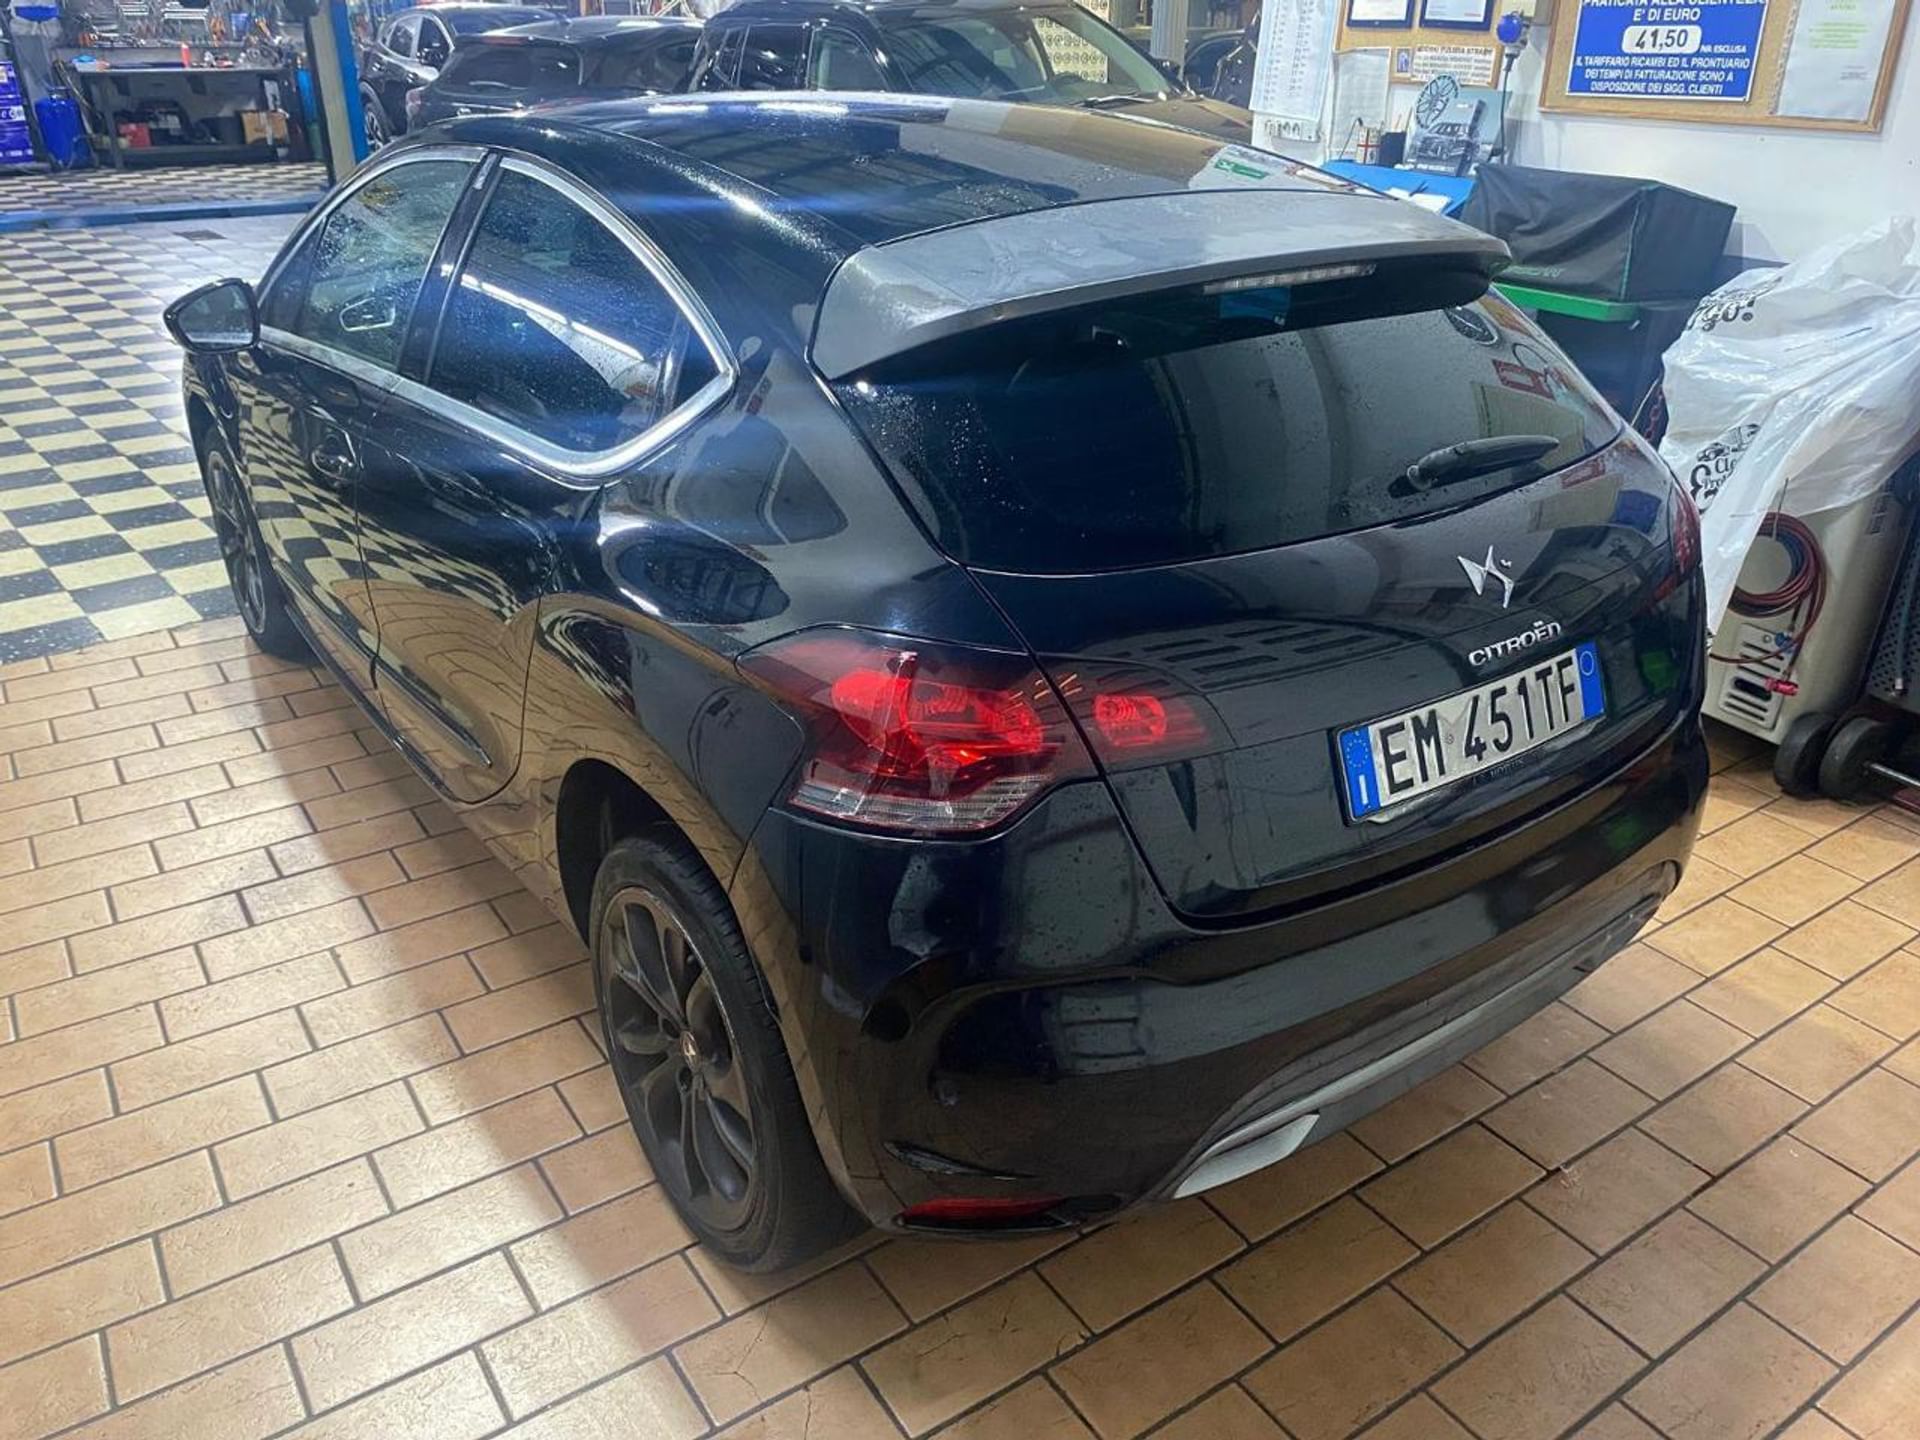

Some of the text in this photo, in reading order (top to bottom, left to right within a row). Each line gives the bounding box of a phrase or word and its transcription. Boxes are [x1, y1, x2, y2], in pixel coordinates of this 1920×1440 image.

[1647, 8, 1662, 21] DI
[1663, 8, 1701, 21] EURO
[1635, 28, 1689, 50] 41,50
[1584, 56, 1630, 67] TARIFFARIO
[1631, 56, 1667, 67] RICAMBI
[1691, 57, 1750, 69] PRONTUARIO
[1585, 69, 1599, 79] DEI
[1600, 69, 1624, 80] TEMPI
[1634, 69, 1698, 81] FATTURAZIONE
[1699, 70, 1725, 81] SONO
[1726, 71, 1734, 81] A
[1590, 81, 1647, 92] DISPOSIZIONE
[1688, 83, 1724, 94] CLIENTI
[1379, 656, 1576, 795] EM 451TF
